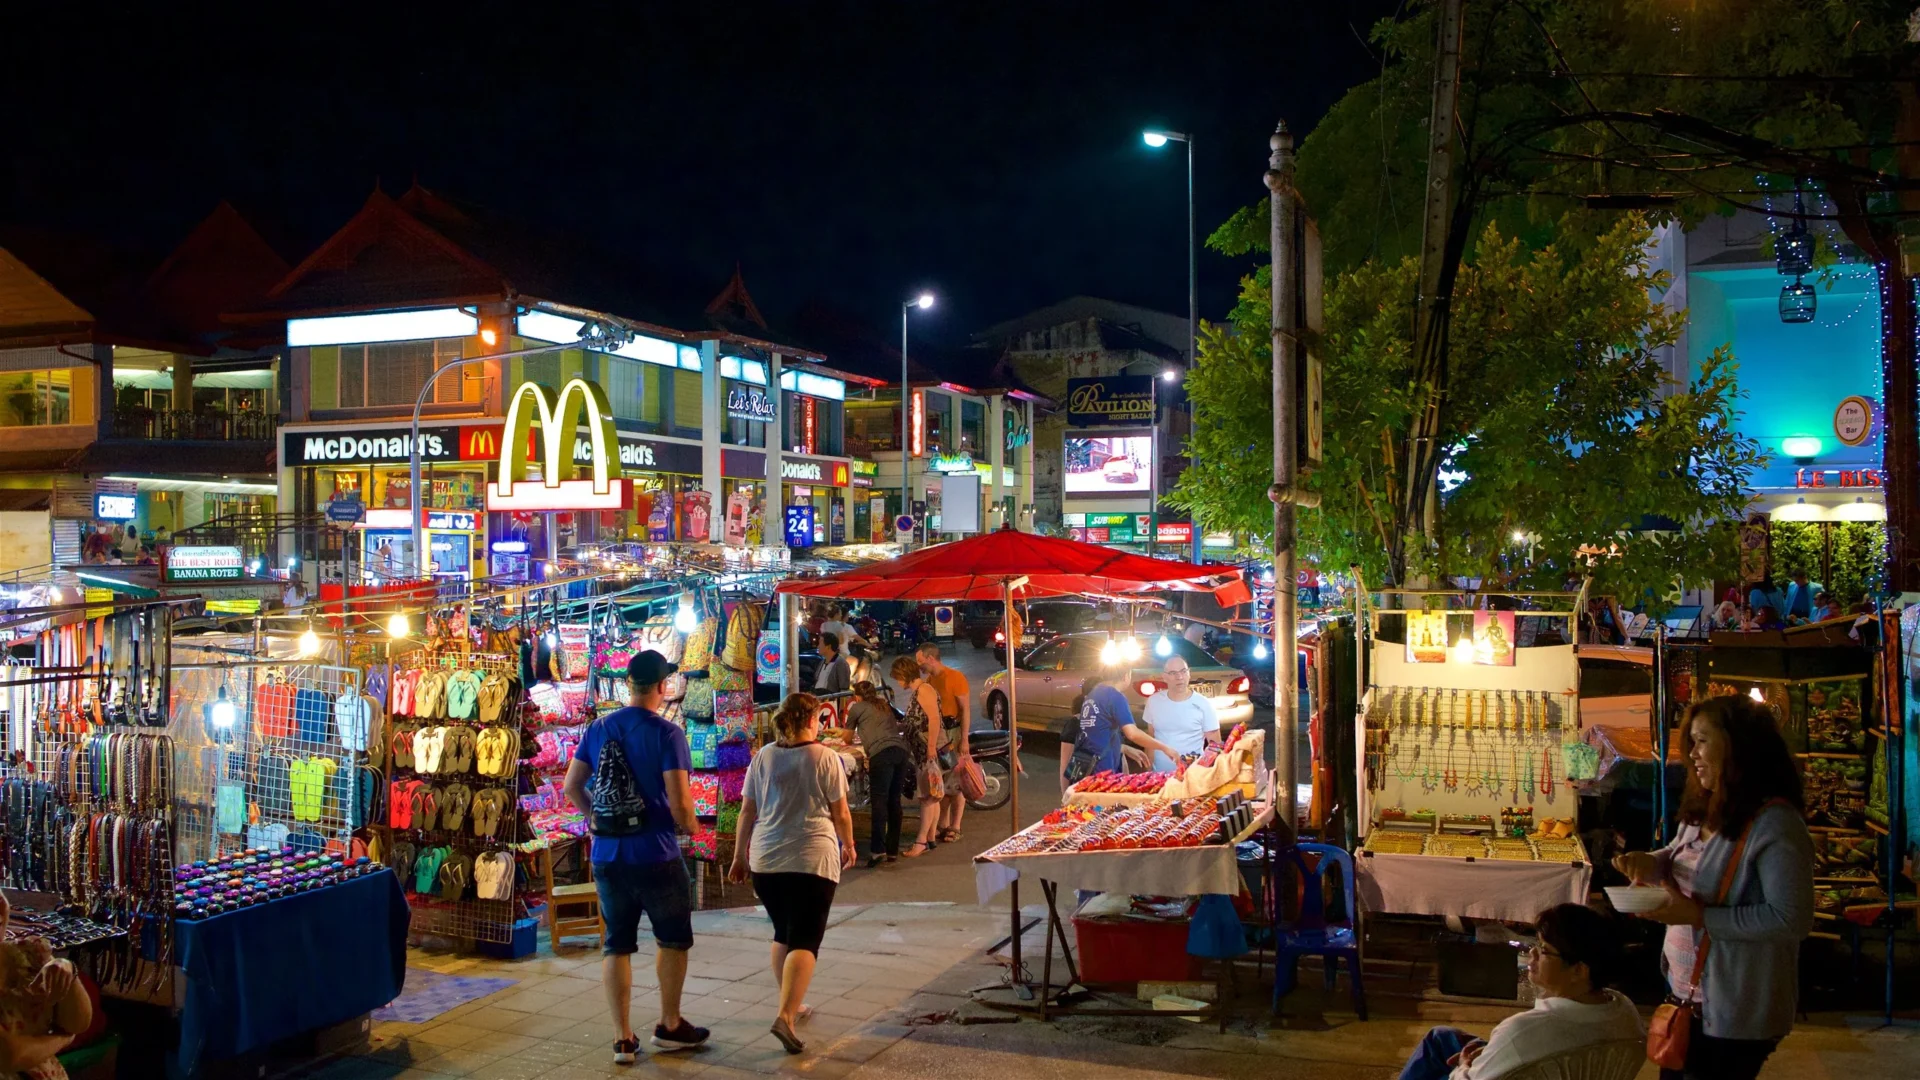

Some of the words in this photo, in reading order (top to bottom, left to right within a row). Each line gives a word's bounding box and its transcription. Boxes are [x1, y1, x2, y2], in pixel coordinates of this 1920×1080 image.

[728, 391, 749, 411] Let's
[750, 394, 775, 416] Relax
[1796, 470, 1825, 488] LE
[913, 520, 924, 528] 24
[1091, 515, 1128, 525] SUBWAY
[789, 518, 809, 533] 24
[171, 559, 187, 567] THE
[189, 559, 210, 567] BEST
[214, 559, 242, 567] ROTEE
[174, 570, 208, 578] BANANA
[210, 569, 238, 578] ROTEE
